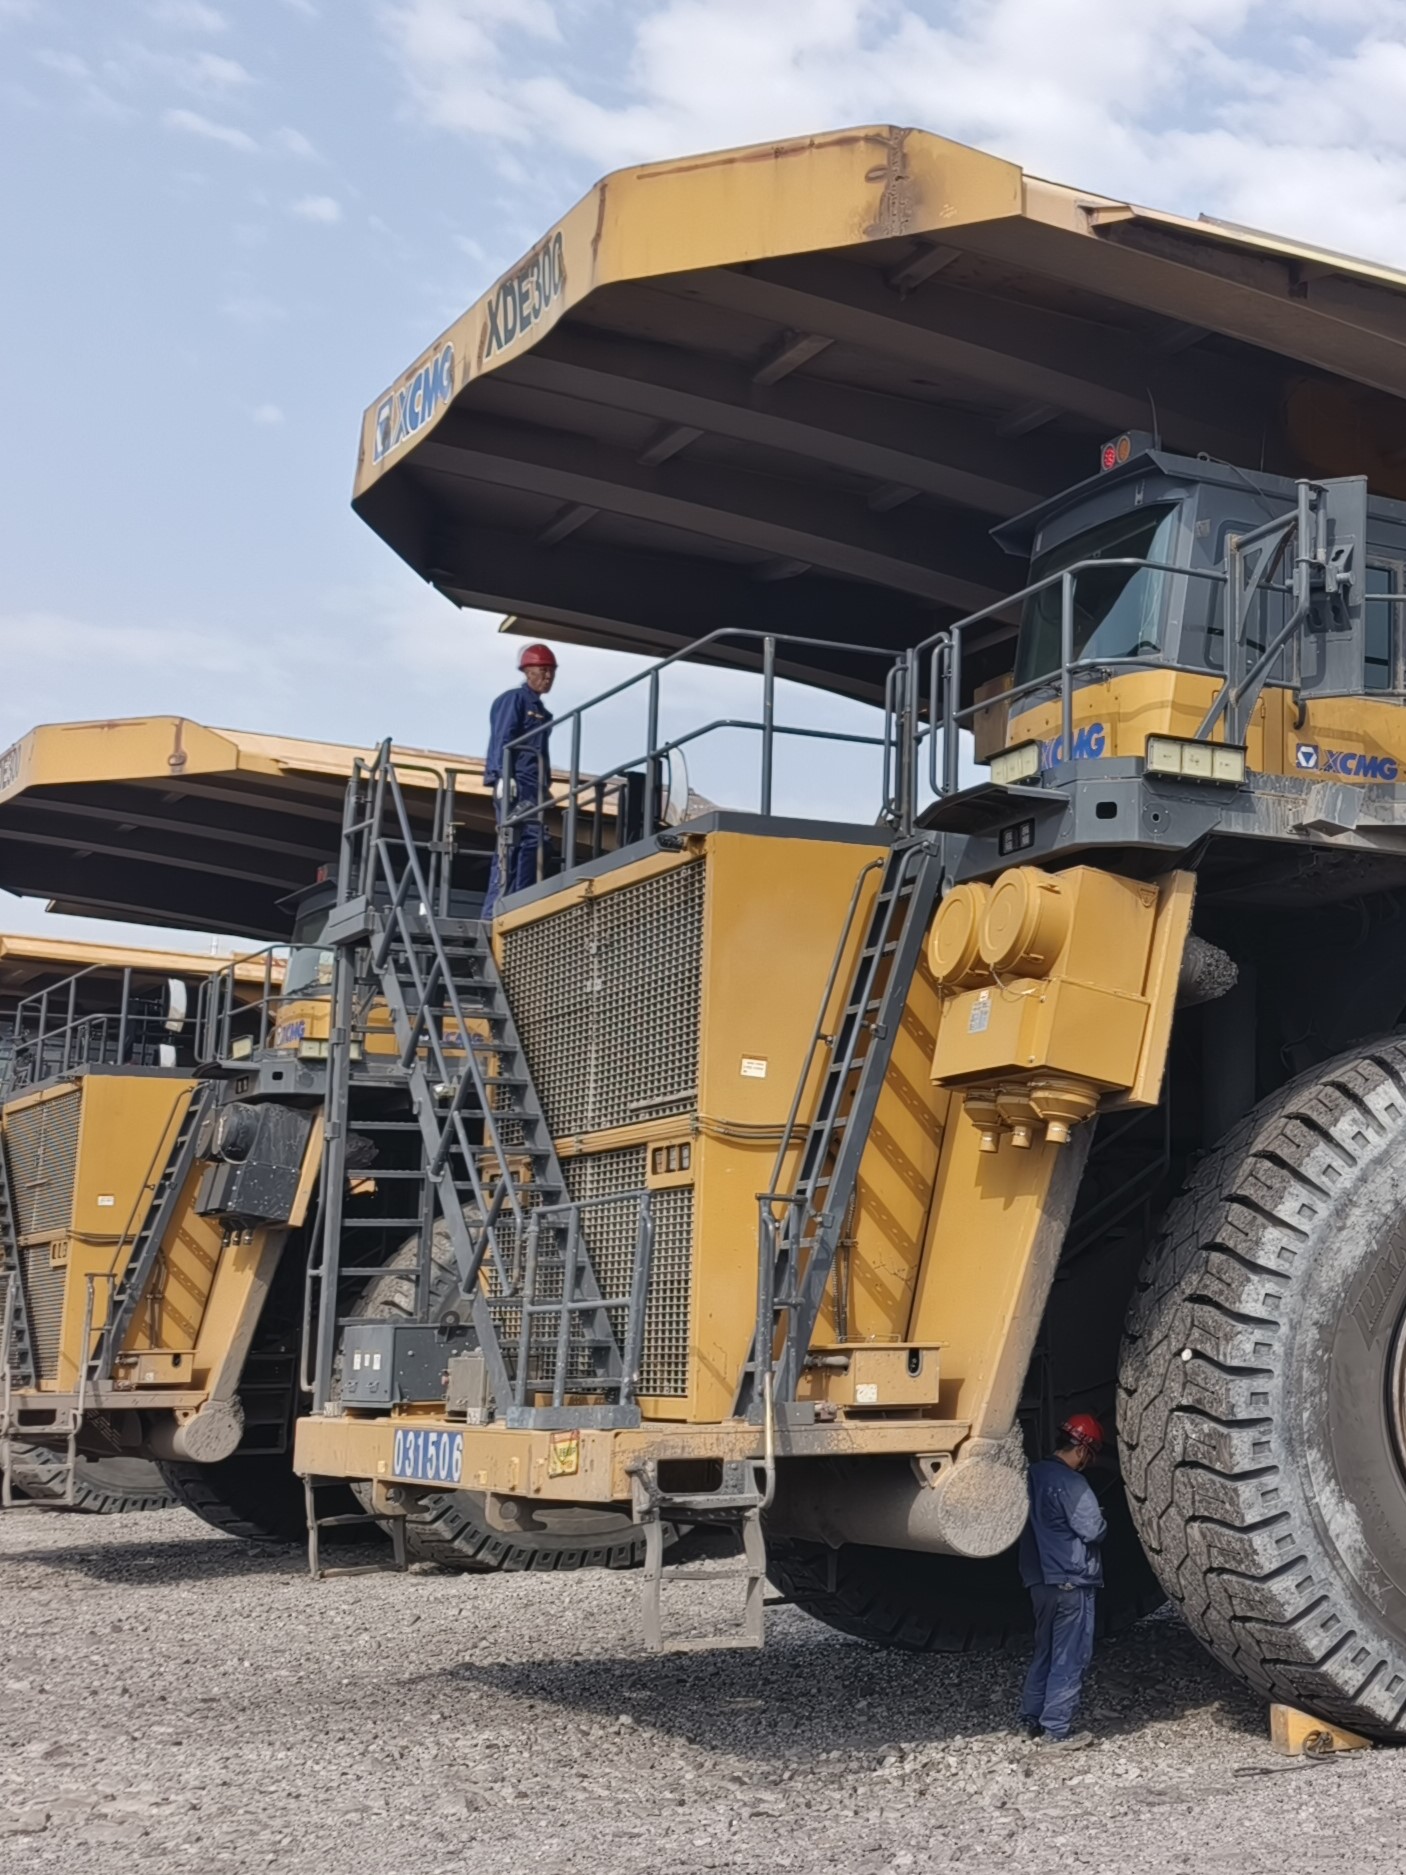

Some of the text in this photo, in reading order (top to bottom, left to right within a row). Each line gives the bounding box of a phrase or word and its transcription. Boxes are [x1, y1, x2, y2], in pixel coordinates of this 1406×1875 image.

[483, 231, 563, 360] XDE300
[1320, 749, 1398, 780] XCMG
[394, 1429, 463, 1482] 031506
